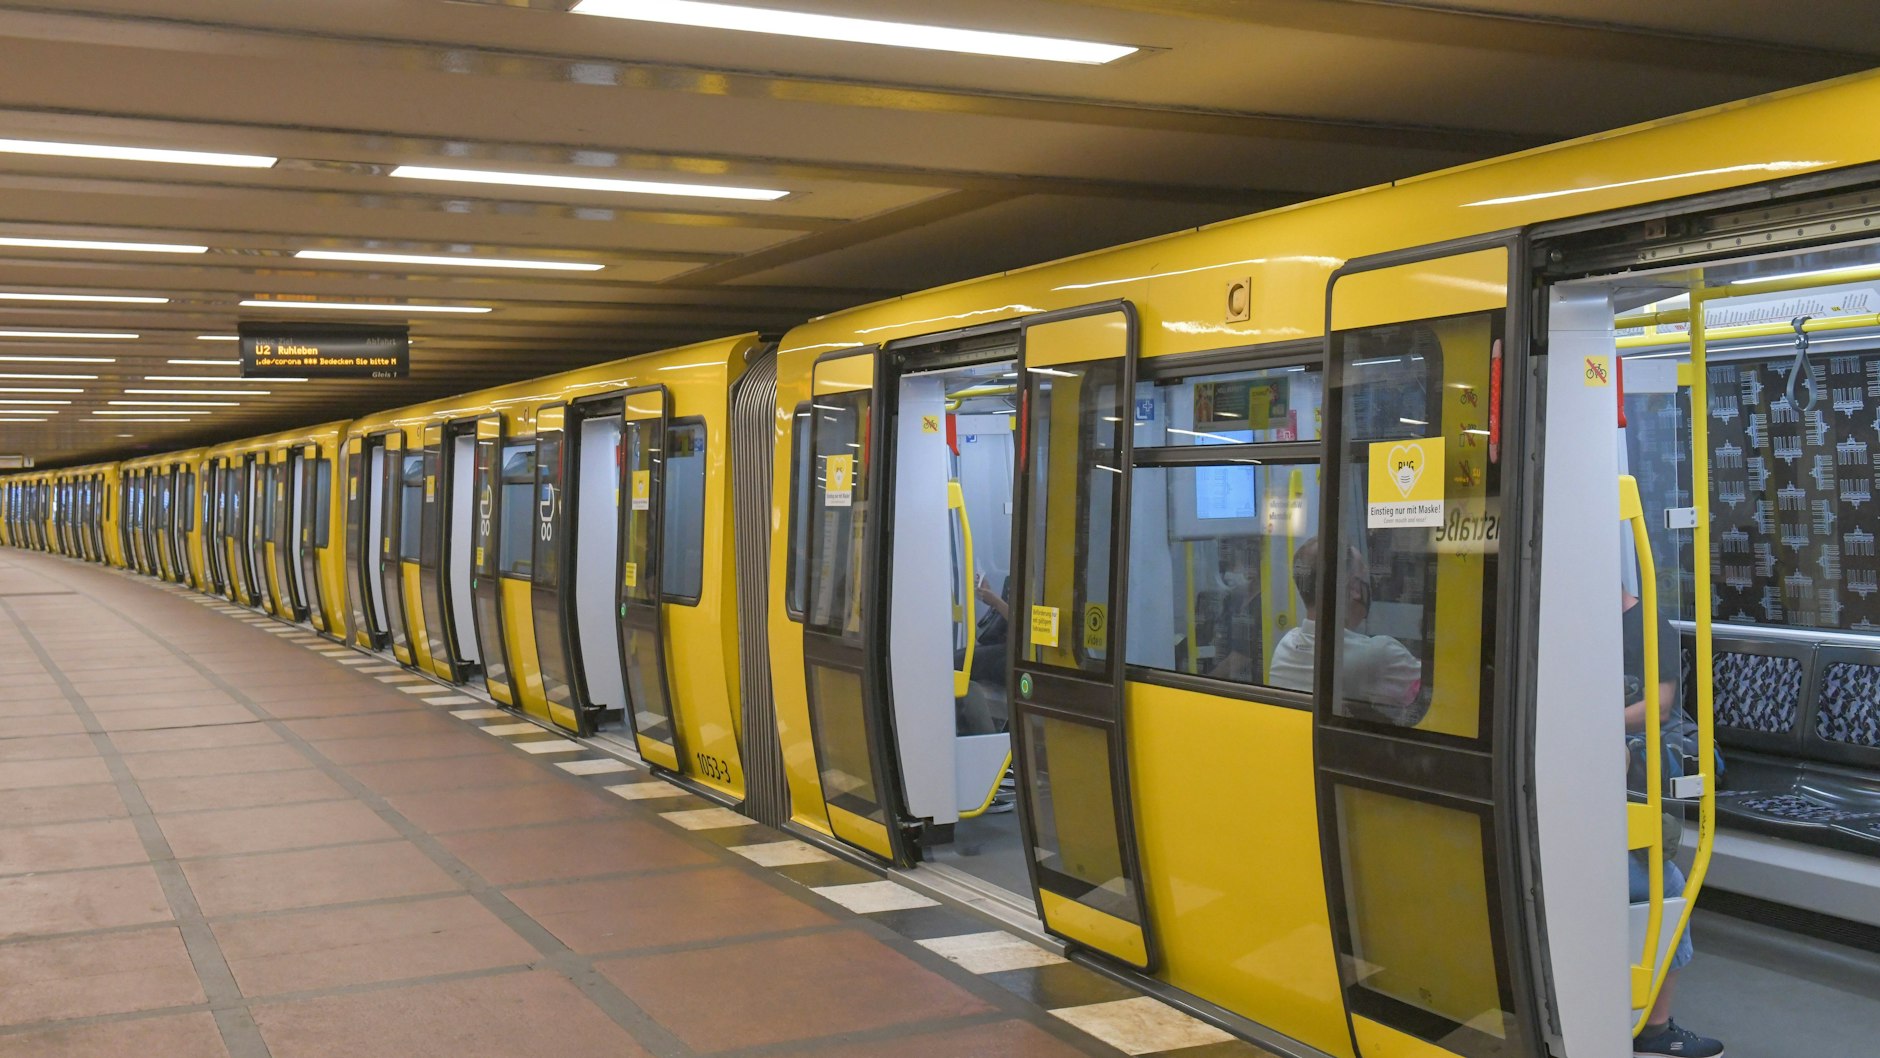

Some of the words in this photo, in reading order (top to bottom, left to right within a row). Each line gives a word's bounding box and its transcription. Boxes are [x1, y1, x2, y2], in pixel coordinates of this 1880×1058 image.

[255, 345, 271, 355] U2
[277, 345, 318, 355] Ruhleben
[319, 358, 354, 366] Bedecken
[369, 358, 389, 366] bitte
[1370, 506, 1394, 517] Einstieg
[1395, 507, 1405, 515] nur
[1406, 506, 1417, 514] mit
[1418, 504, 1441, 514] Maske!
[1087, 634, 1102, 646] Video
[697, 752, 731, 784] 1053-3
